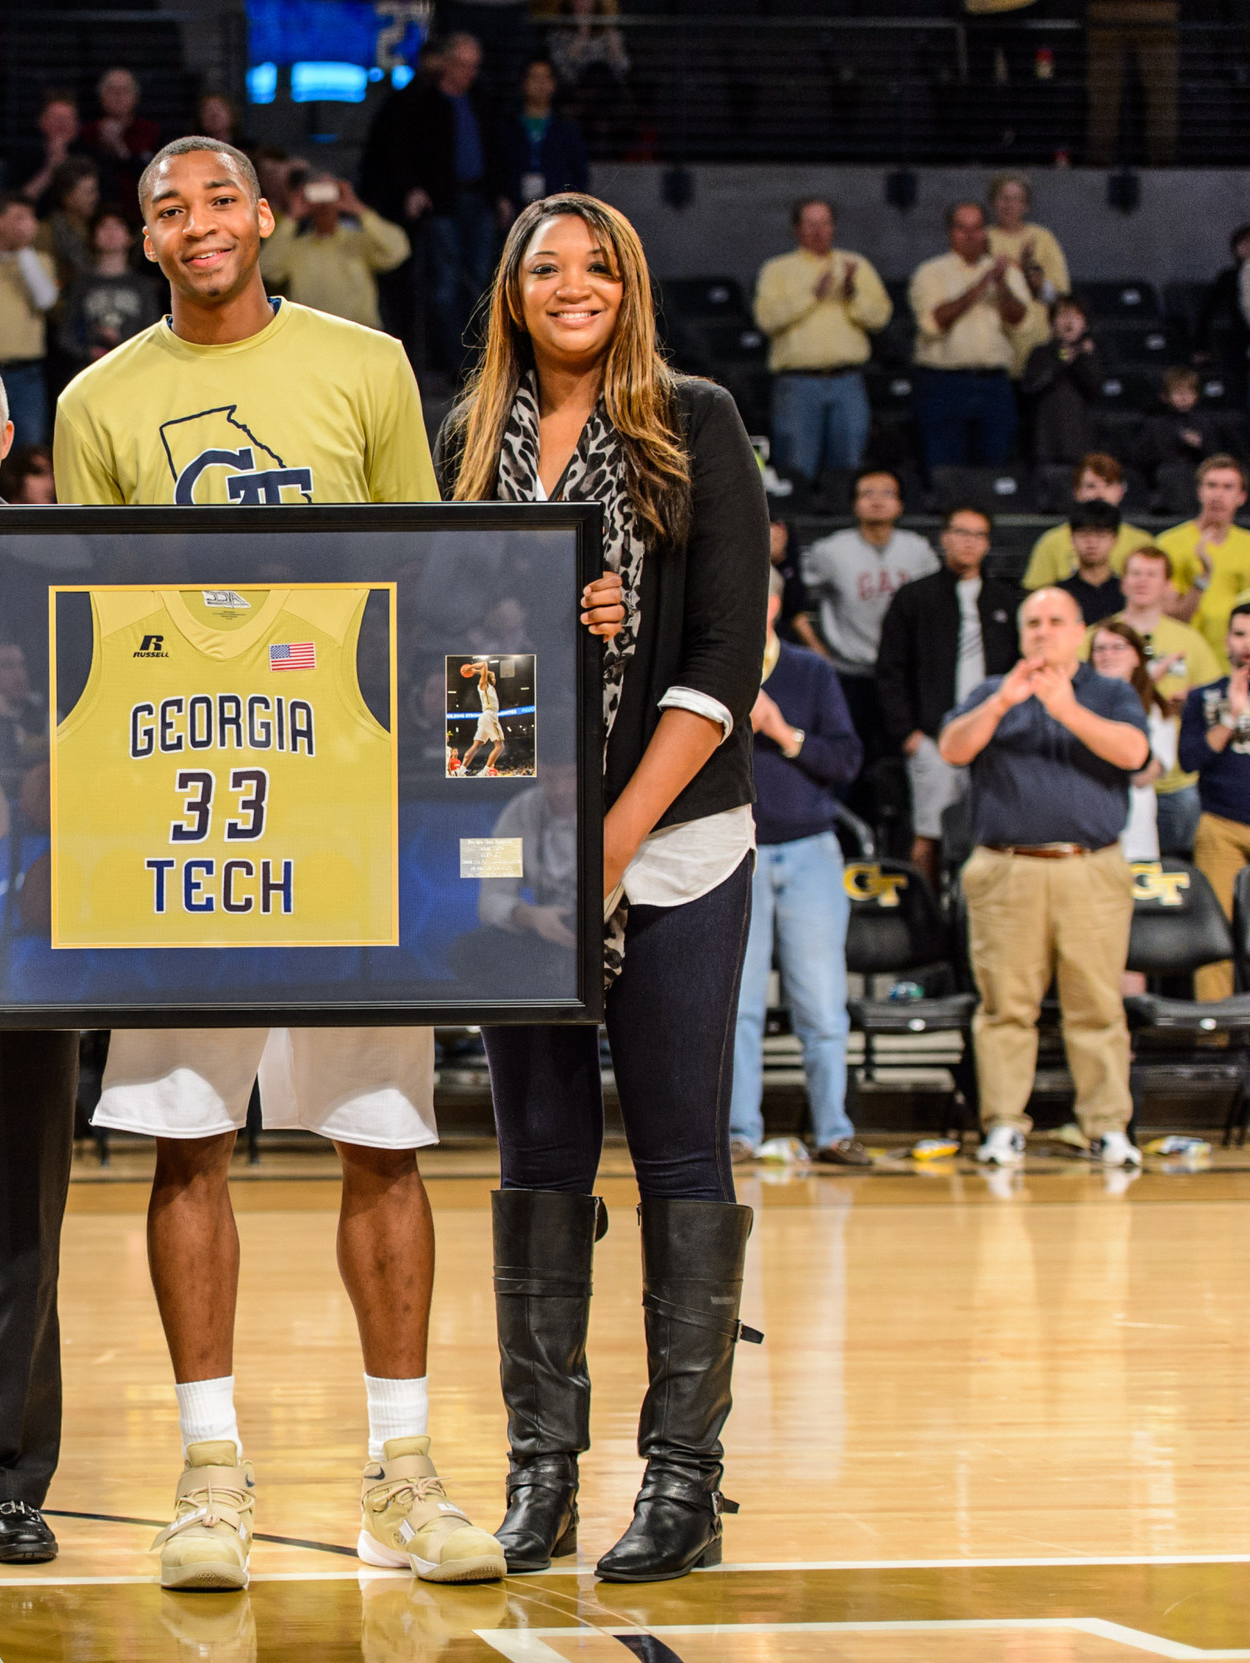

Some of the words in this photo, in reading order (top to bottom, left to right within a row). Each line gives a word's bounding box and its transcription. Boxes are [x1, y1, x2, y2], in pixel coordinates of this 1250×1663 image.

[129, 693, 315, 759] GEORGIA
[168, 767, 270, 844] 33
[145, 858, 294, 914] TECH
[843, 863, 908, 907] GT
